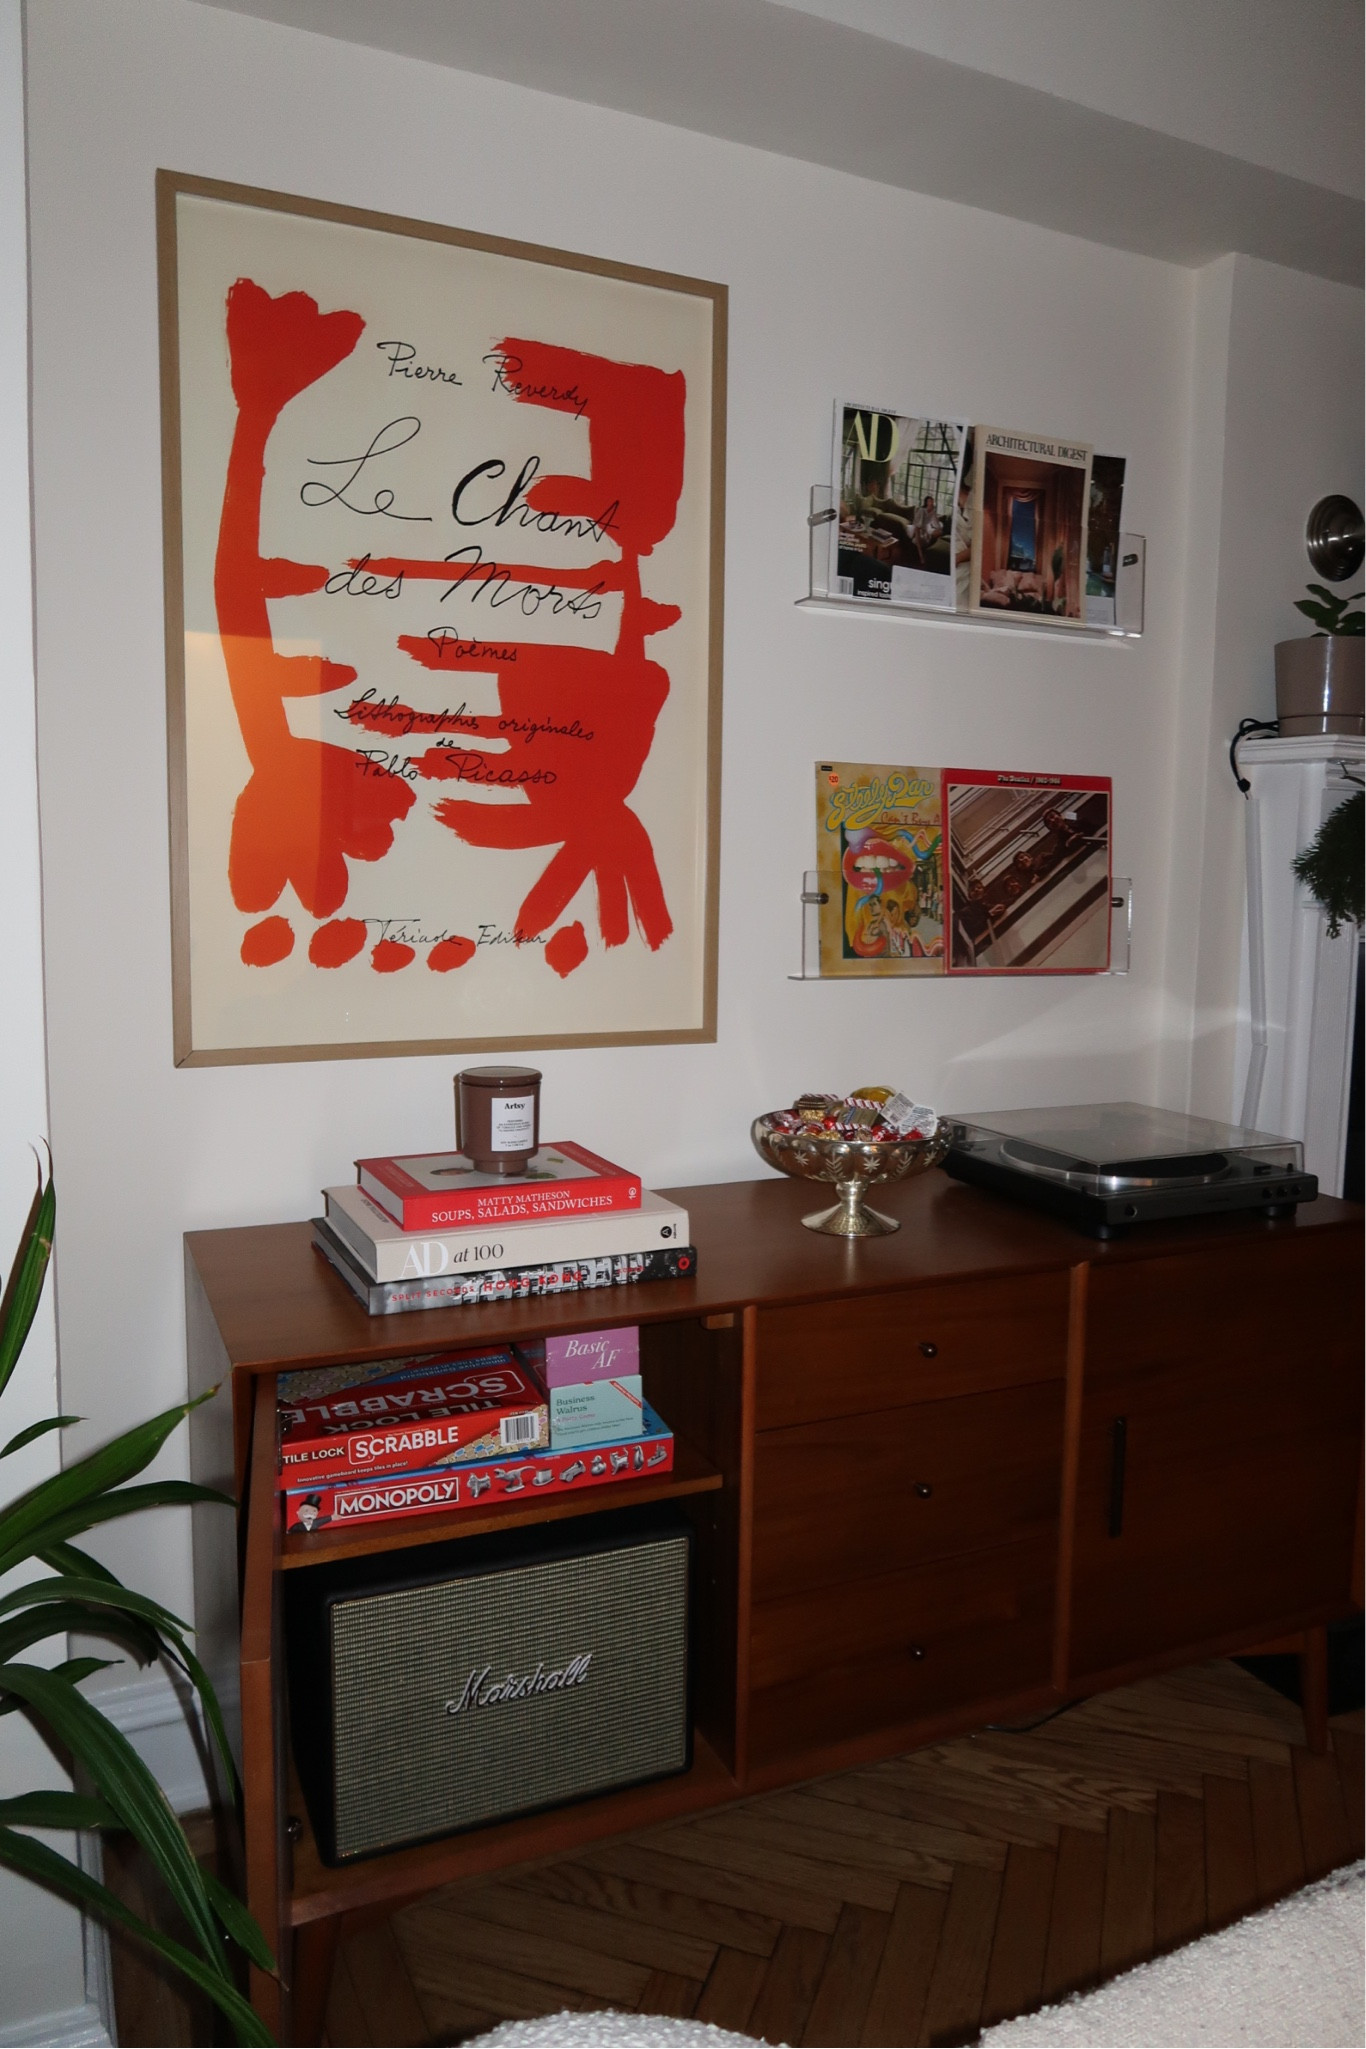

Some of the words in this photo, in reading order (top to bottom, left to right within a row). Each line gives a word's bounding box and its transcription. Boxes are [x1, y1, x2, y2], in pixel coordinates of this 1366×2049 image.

[376, 341, 462, 385] Pierre
[482, 354, 588, 420] Reverdy
[842, 410, 899, 463] AD
[986, 434, 1055, 456] ARCHITECTURAL
[1058, 446, 1088, 461] DIGEST
[300, 416, 432, 521] Le
[452, 456, 619, 542] Chant
[325, 553, 404, 599] des
[440, 546, 605, 619] Morts
[868, 578, 892, 593] sing
[428, 626, 517, 662] Poèmes
[436, 737, 461, 750] de
[498, 717, 595, 743] originales
[356, 749, 420, 781] Pablo
[445, 753, 558, 785] Picasso
[885, 771, 934, 808] Dan
[431, 1209, 474, 1223] SOUPS,
[477, 1204, 529, 1218] SALADS,
[532, 1195, 613, 1212] SANDWICHES
[478, 1196, 513, 1207] MATTY
[515, 1191, 570, 1203] MATHESON
[400, 1241, 449, 1279] AD
[453, 1248, 470, 1263] at
[474, 1243, 504, 1261] 100
[391, 1292, 422, 1302] SPLIT
[426, 1285, 475, 1298] SECONDS
[483, 1277, 531, 1292] HONG
[539, 1271, 583, 1286] KONG
[565, 1336, 610, 1358] Basic
[591, 1348, 622, 1370] AF
[291, 1377, 508, 1424] SCRABBLE
[428, 1401, 504, 1416] TILE
[556, 1395, 595, 1406] Business
[556, 1404, 588, 1415] Walrus
[324, 1412, 421, 1434] LOCK
[283, 1452, 308, 1464] TILE
[312, 1446, 345, 1460] LOCK
[355, 1426, 459, 1459] SCRABBLE
[297, 1474, 325, 1482] Innovative
[326, 1469, 357, 1479] gameboard
[357, 1466, 373, 1475] keeps
[392, 1460, 408, 1469] place!
[339, 1481, 455, 1515] MONOPOLY
[445, 1653, 592, 1714] Marshall
